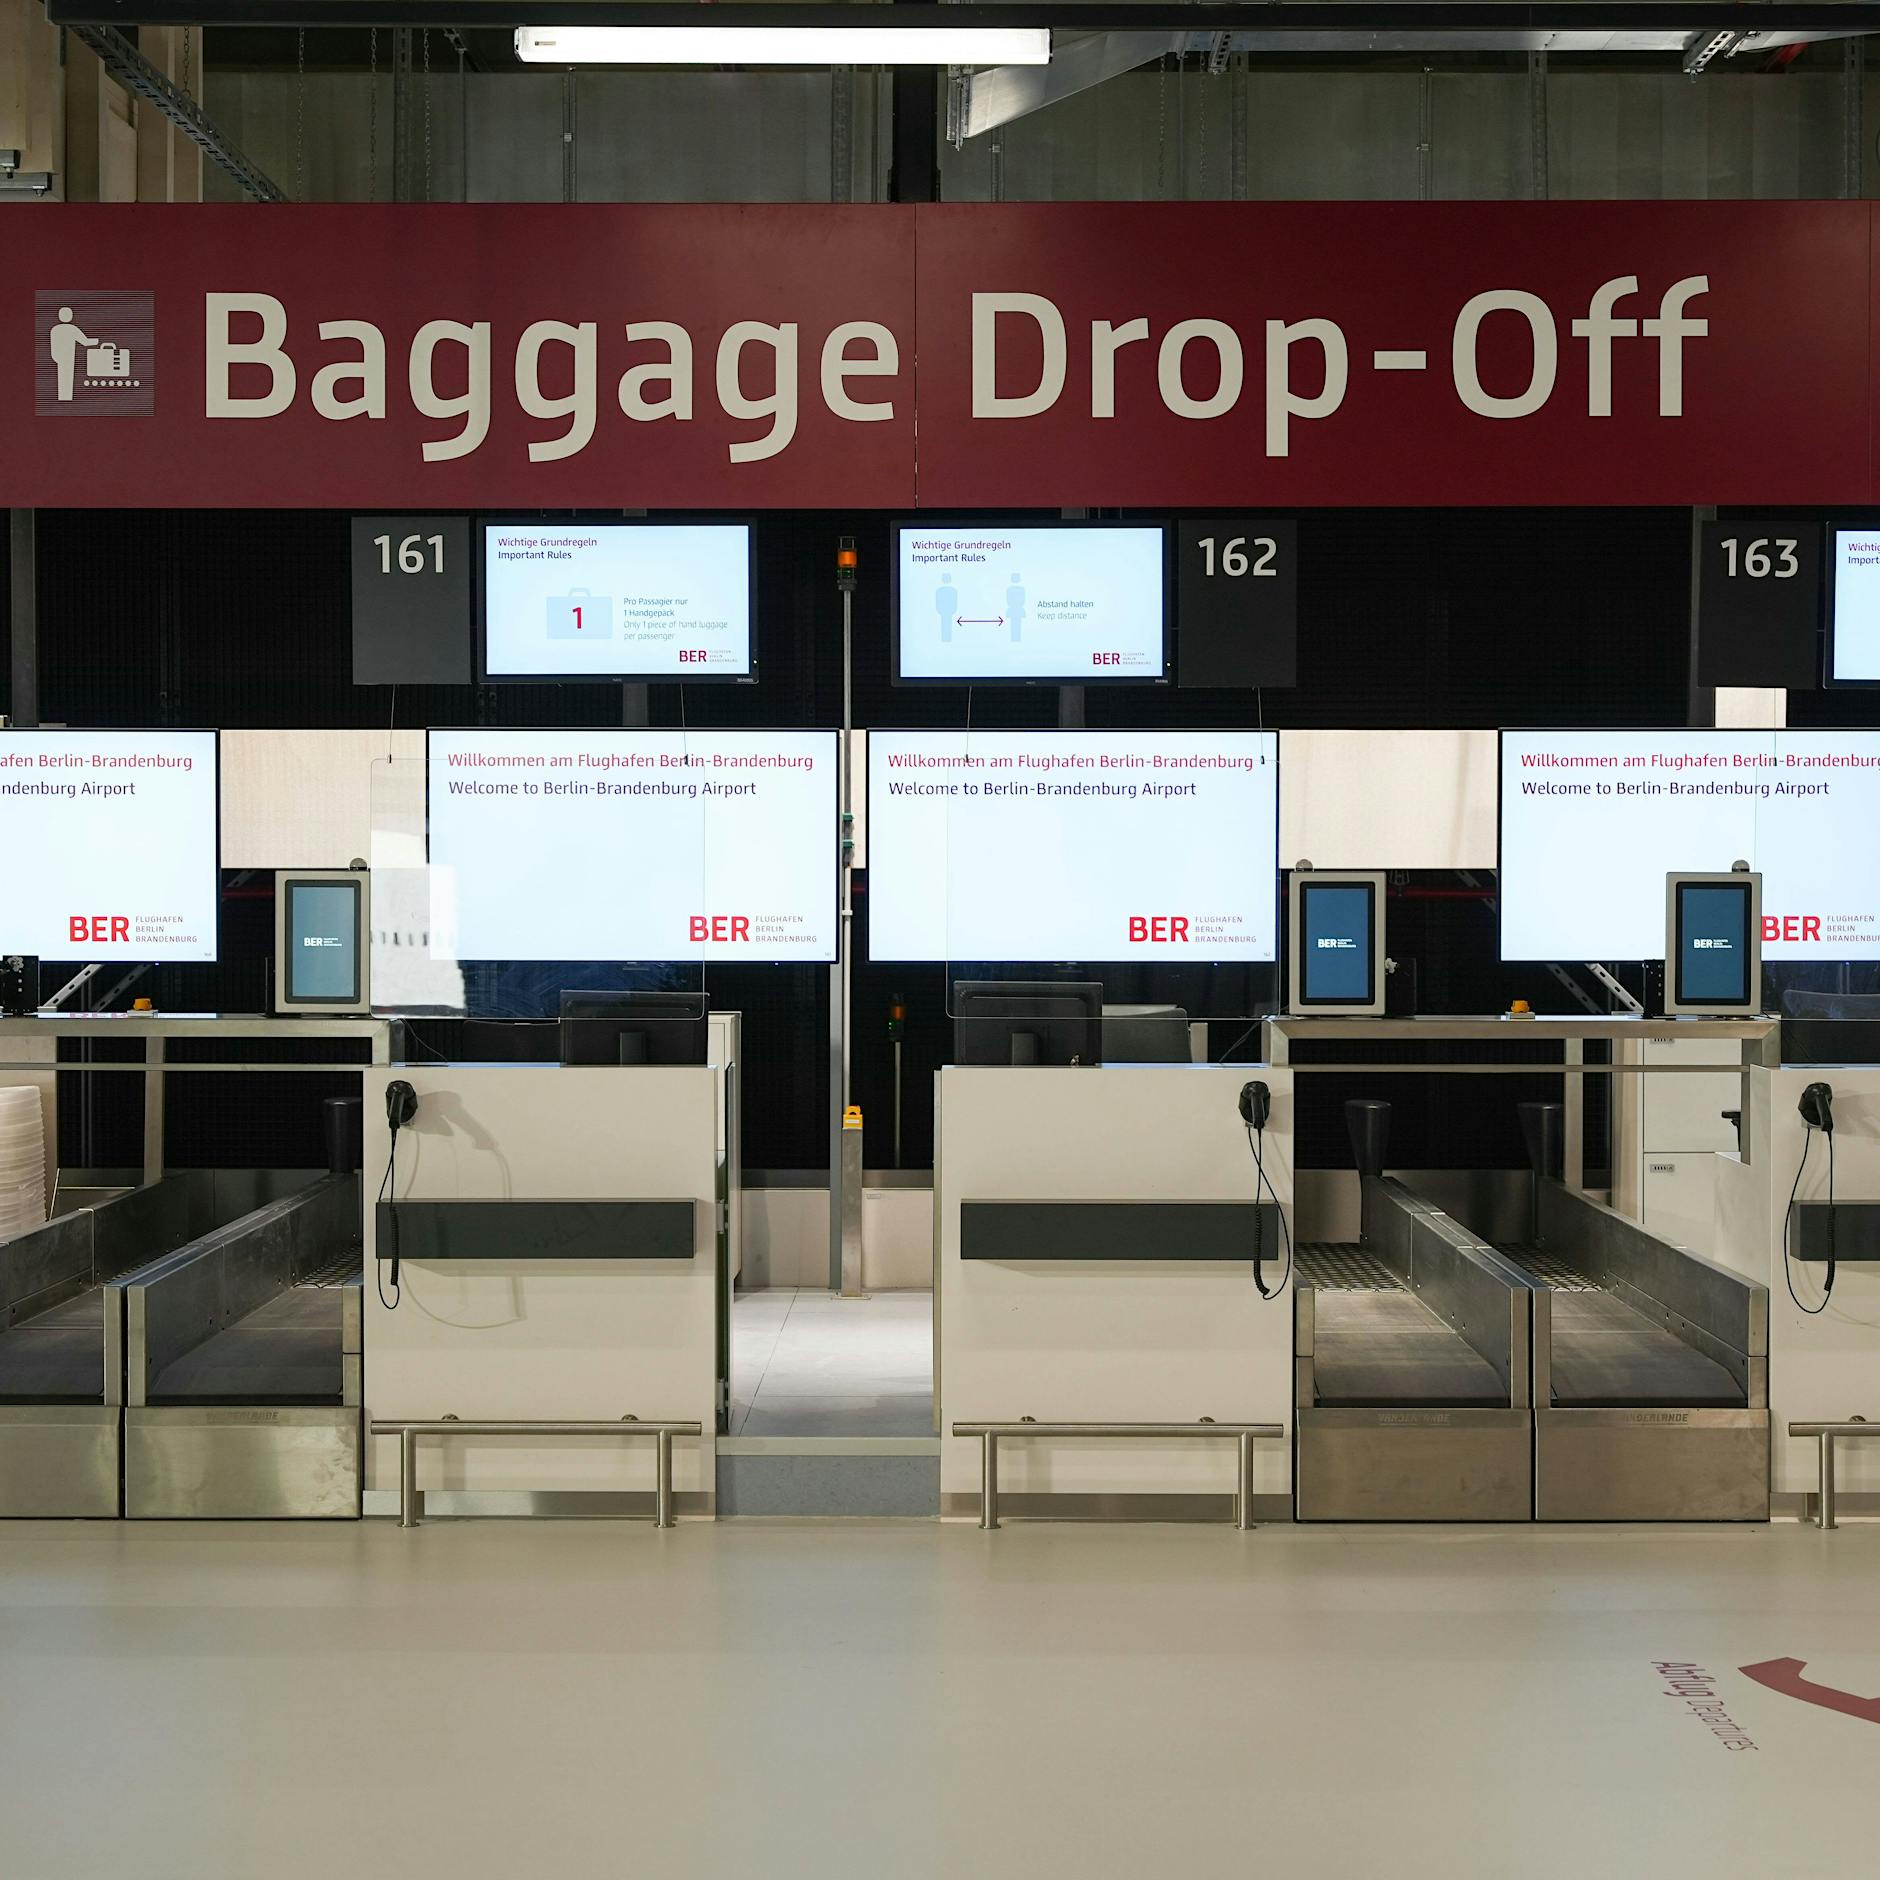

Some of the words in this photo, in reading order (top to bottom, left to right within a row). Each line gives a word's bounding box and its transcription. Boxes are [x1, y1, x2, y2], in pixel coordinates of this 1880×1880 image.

[205, 292, 899, 463] Baggage
[972, 275, 1709, 456] Drop-Off
[497, 538, 538, 549] Wichtige
[540, 538, 598, 549] Grundregeln
[912, 540, 952, 551] Wichtige
[954, 540, 1012, 552] Grundregeln
[374, 535, 443, 573] 161
[498, 550, 545, 561] Important
[547, 550, 572, 560] Rules
[912, 553, 959, 564] Important
[961, 553, 987, 563] Rules
[1199, 538, 1276, 576] 162
[1721, 539, 1798, 577] 163
[639, 598, 672, 607] Passagier
[1037, 600, 1069, 609] Abstand
[1070, 600, 1094, 609] halten
[572, 606, 582, 629] 1
[623, 609, 628, 617] 1
[1037, 611, 1056, 621] Keep
[1057, 611, 1088, 620] distance
[624, 620, 641, 630] Only
[668, 620, 677, 629] of
[679, 620, 697, 629] hand
[623, 633, 636, 641] per
[679, 650, 707, 662] BER
[1093, 652, 1121, 665] BER
[0, 754, 32, 768] afen
[38, 754, 192, 772] Berlin-Brandenburg
[447, 753, 544, 767] Willkommen
[549, 757, 572, 767] am
[578, 754, 654, 771] Flughafen
[887, 754, 984, 768] Willkommen
[989, 758, 1012, 768] am
[1018, 754, 1094, 772] Flughafen
[1100, 754, 1252, 772] Berlin-Brandenburg
[1521, 754, 1617, 768] Willkommen
[1622, 758, 1645, 768] am
[1651, 754, 1727, 771] Flughafen
[1733, 754, 1880, 771] Berlin-Brandenbur
[2, 781, 75, 799] ndenburg
[81, 782, 135, 799] Airport
[448, 781, 518, 795] Welcome
[522, 782, 538, 795] to
[544, 781, 696, 799] Berlin-Brandenburg
[701, 782, 755, 799] Airport
[888, 782, 958, 795] Welcome
[962, 783, 978, 795] to
[984, 782, 1136, 799] Berlin-Brandenburg
[1142, 782, 1196, 799] Airport
[1521, 782, 1590, 795] Welcome
[1595, 783, 1610, 795] to
[1616, 782, 1769, 799] Berlin-Brandenburg
[1774, 782, 1829, 799] Airport
[1195, 916, 1242, 924] FLUGHAFEN
[70, 916, 129, 942] BER
[690, 916, 749, 941] BER
[1130, 917, 1188, 942] BER
[1761, 916, 1821, 942] BER
[1826, 925, 1855, 933] BERLIN
[304, 938, 323, 946] BER
[1194, 936, 1256, 944] BRANDENBURG
[1318, 939, 1337, 948] BER
[1694, 939, 1713, 948] BER
[1650, 1661, 1717, 1697] Abflug
[1684, 1700, 1760, 1751] Departures
